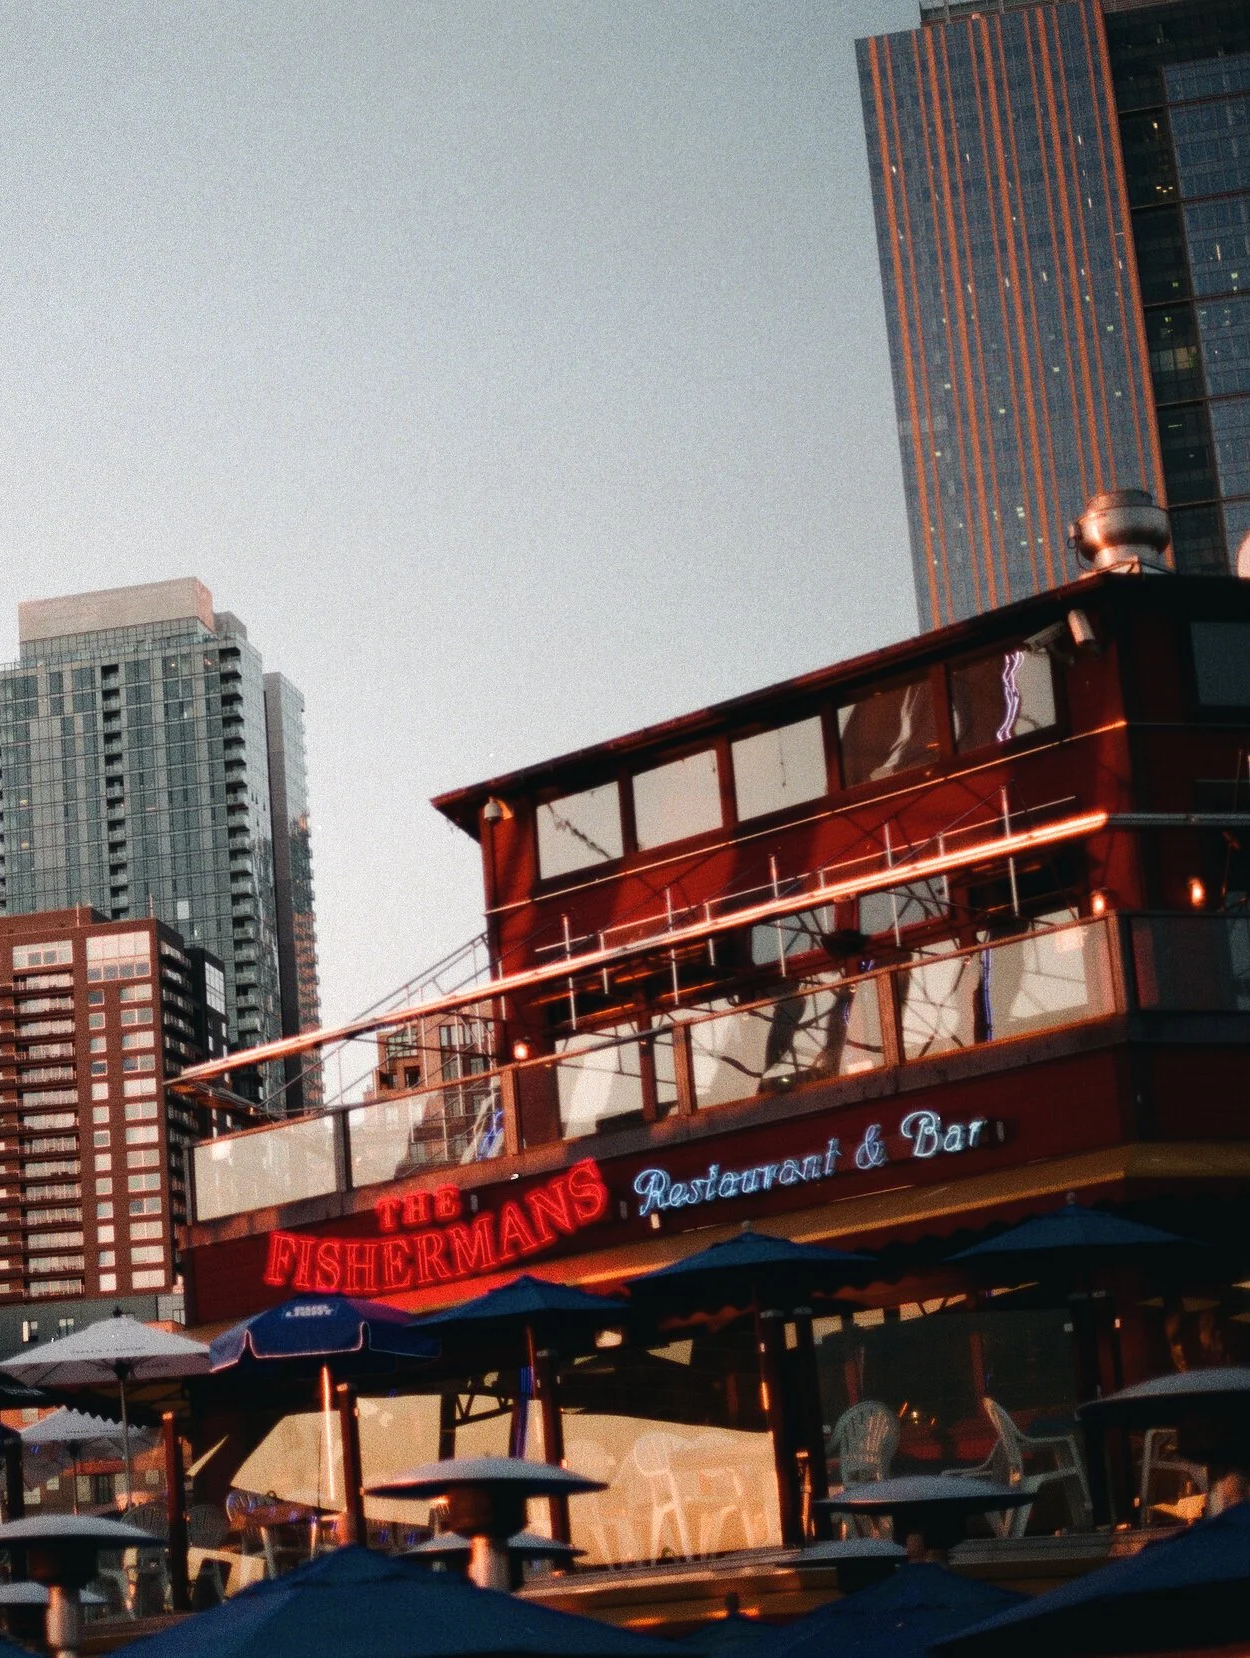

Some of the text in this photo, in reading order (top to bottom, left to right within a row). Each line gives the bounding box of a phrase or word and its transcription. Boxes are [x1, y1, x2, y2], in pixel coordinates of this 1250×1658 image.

[377, 1184, 462, 1231] THE
[634, 1110, 988, 1217] Restaurant & Bar
[266, 1158, 607, 1293] FISHERMANS
